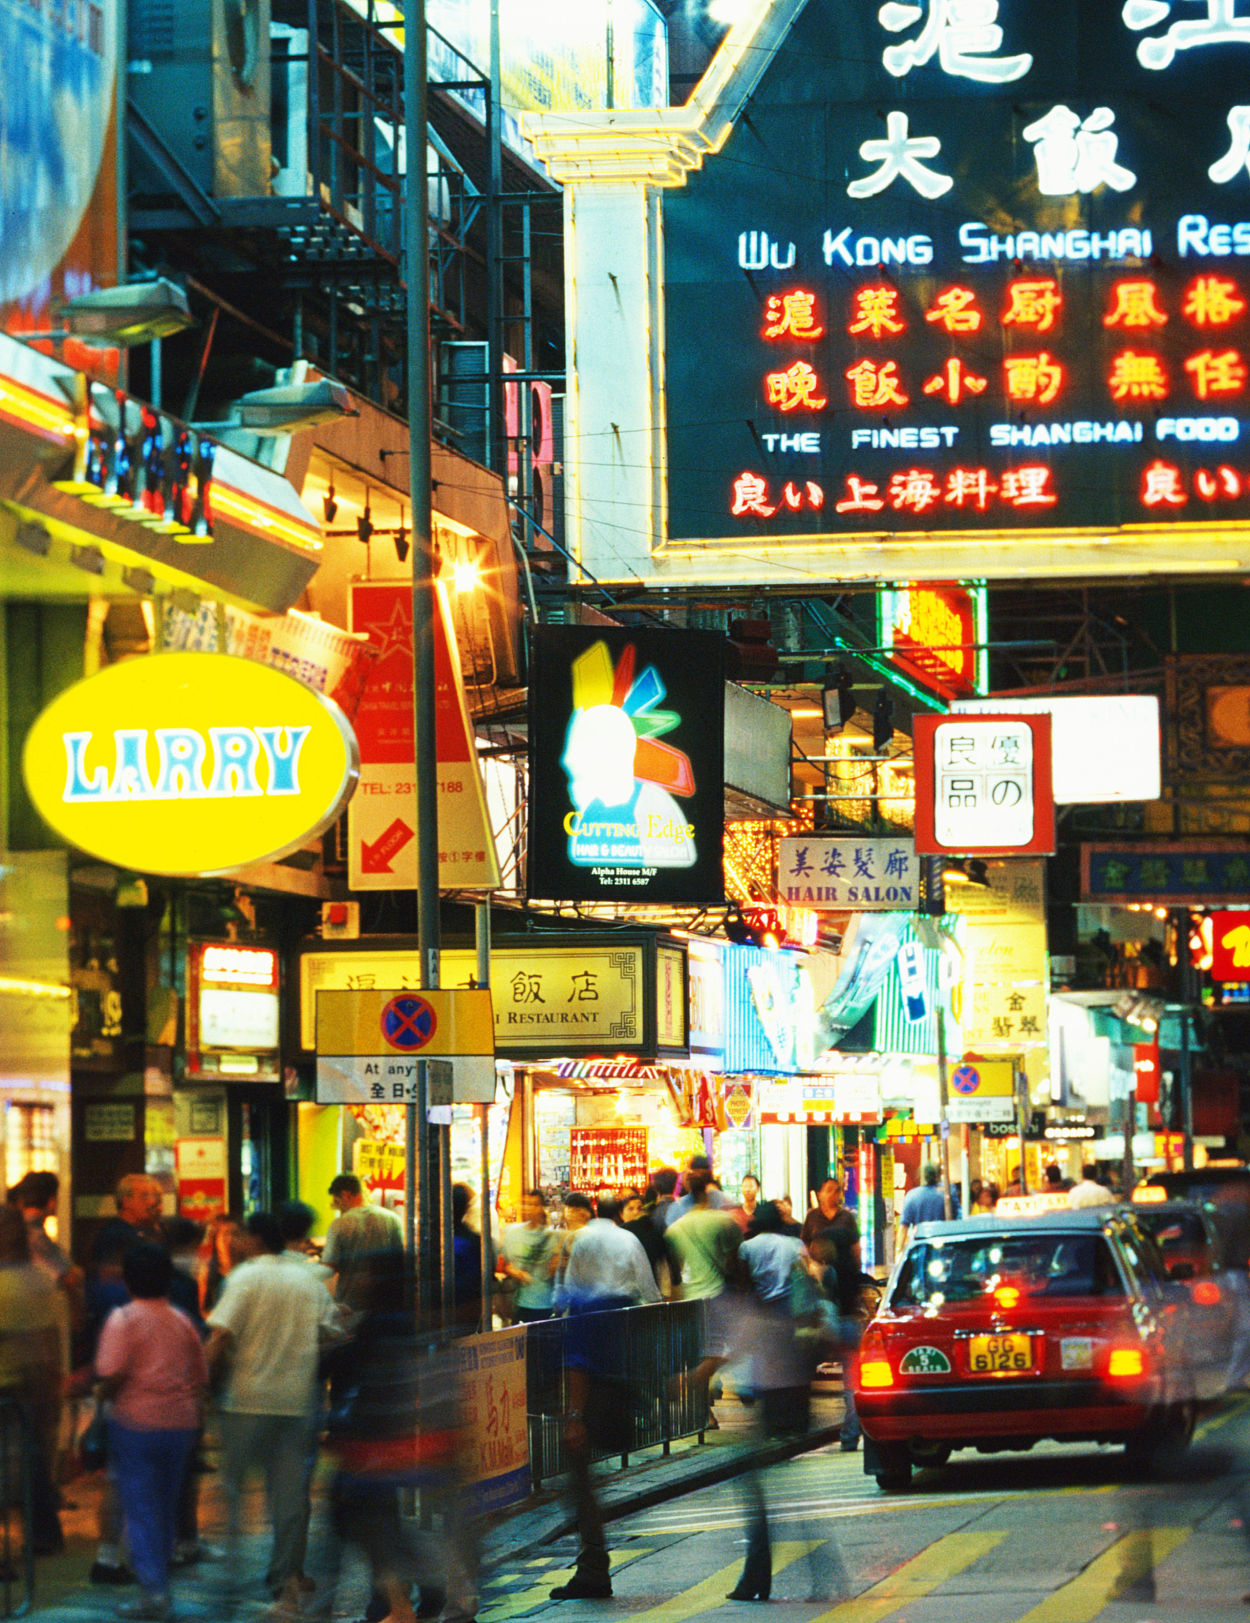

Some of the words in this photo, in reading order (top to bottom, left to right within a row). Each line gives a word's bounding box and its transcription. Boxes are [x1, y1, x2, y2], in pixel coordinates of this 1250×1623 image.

[762, 432, 820, 453] THE
[851, 426, 959, 449] FINEST
[990, 421, 1143, 446] SHANGHAI
[1155, 416, 1240, 442] FOOD
[62, 725, 312, 803] LARRY
[646, 814, 696, 844] Edge
[788, 846, 909, 880] 美姿髮廊
[591, 867, 615, 877] Alpha
[616, 867, 640, 876] House
[599, 877, 613, 885] Tel:
[787, 886, 838, 901] HAIR
[848, 886, 912, 901] SALON
[1005, 992, 1027, 1012] 金
[508, 1010, 600, 1025] RESTAURANT
[364, 1063, 379, 1075] At
[388, 1065, 412, 1076] any
[987, 1338, 1014, 1353] GG
[920, 1354, 930, 1366] 5
[974, 1353, 1026, 1371] 6126
